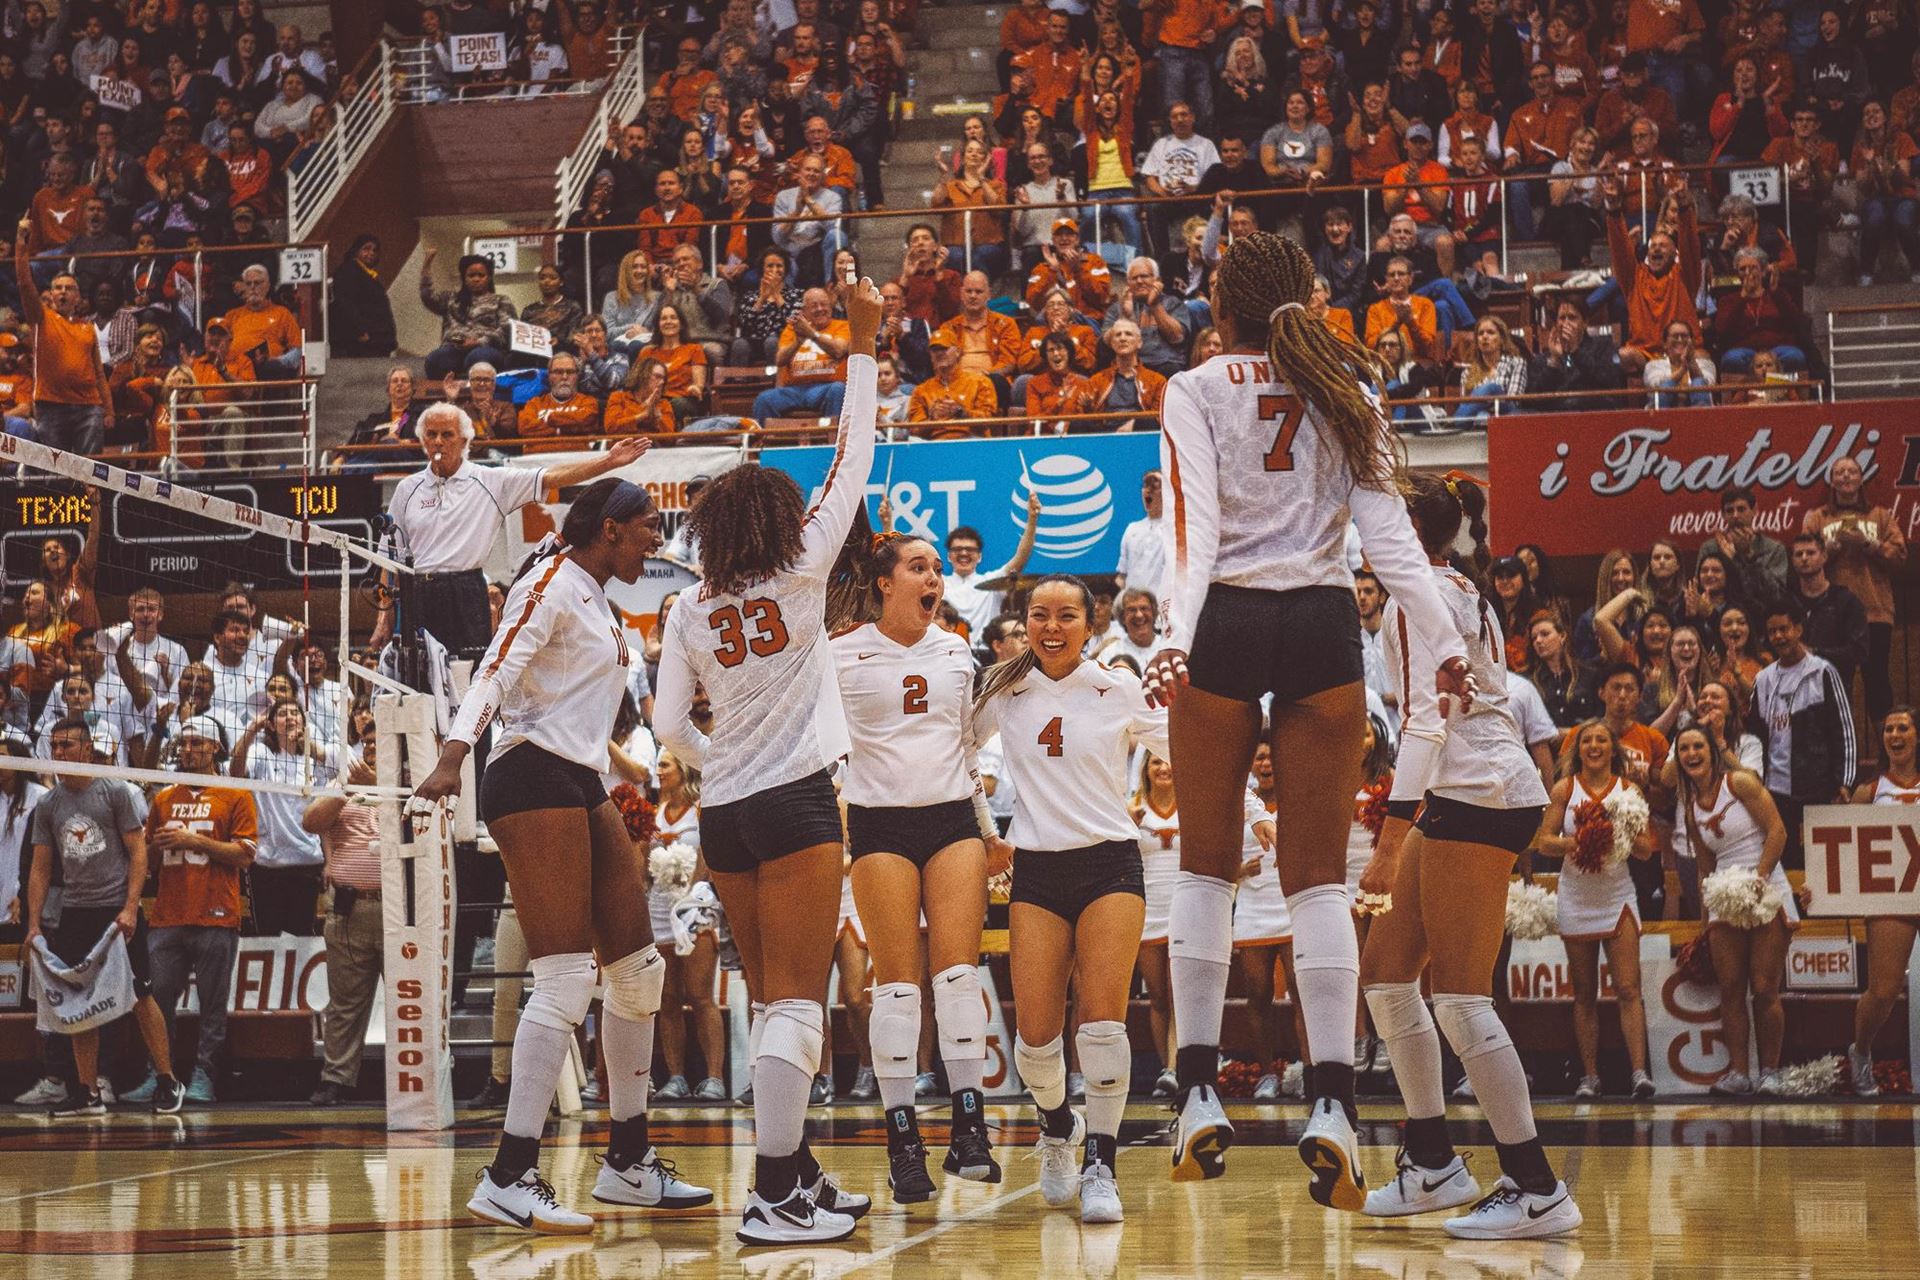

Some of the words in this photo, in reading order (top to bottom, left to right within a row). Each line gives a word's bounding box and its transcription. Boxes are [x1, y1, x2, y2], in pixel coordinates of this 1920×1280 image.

[458, 36, 498, 51] POINT
[1744, 181, 1768, 201] 33
[291, 262, 312, 280] 32
[1257, 394, 1305, 472] 7
[1540, 442, 1570, 499] i
[1589, 423, 1882, 495] Fratelli
[17, 495, 92, 526] TEXAS
[235, 503, 263, 526] TEXAS
[289, 485, 338, 515] TCU
[1752, 497, 1799, 533] ust
[150, 555, 199, 572] PERIOD
[641, 568, 675, 579] AMAHA
[708, 596, 790, 668] 33
[903, 674, 928, 715] 2
[473, 703, 493, 739] HORNS
[1037, 717, 1063, 757] 4
[171, 803, 211, 818] TEXAS
[1791, 952, 1850, 974] CHEER
[396, 979, 424, 1093] senoh
